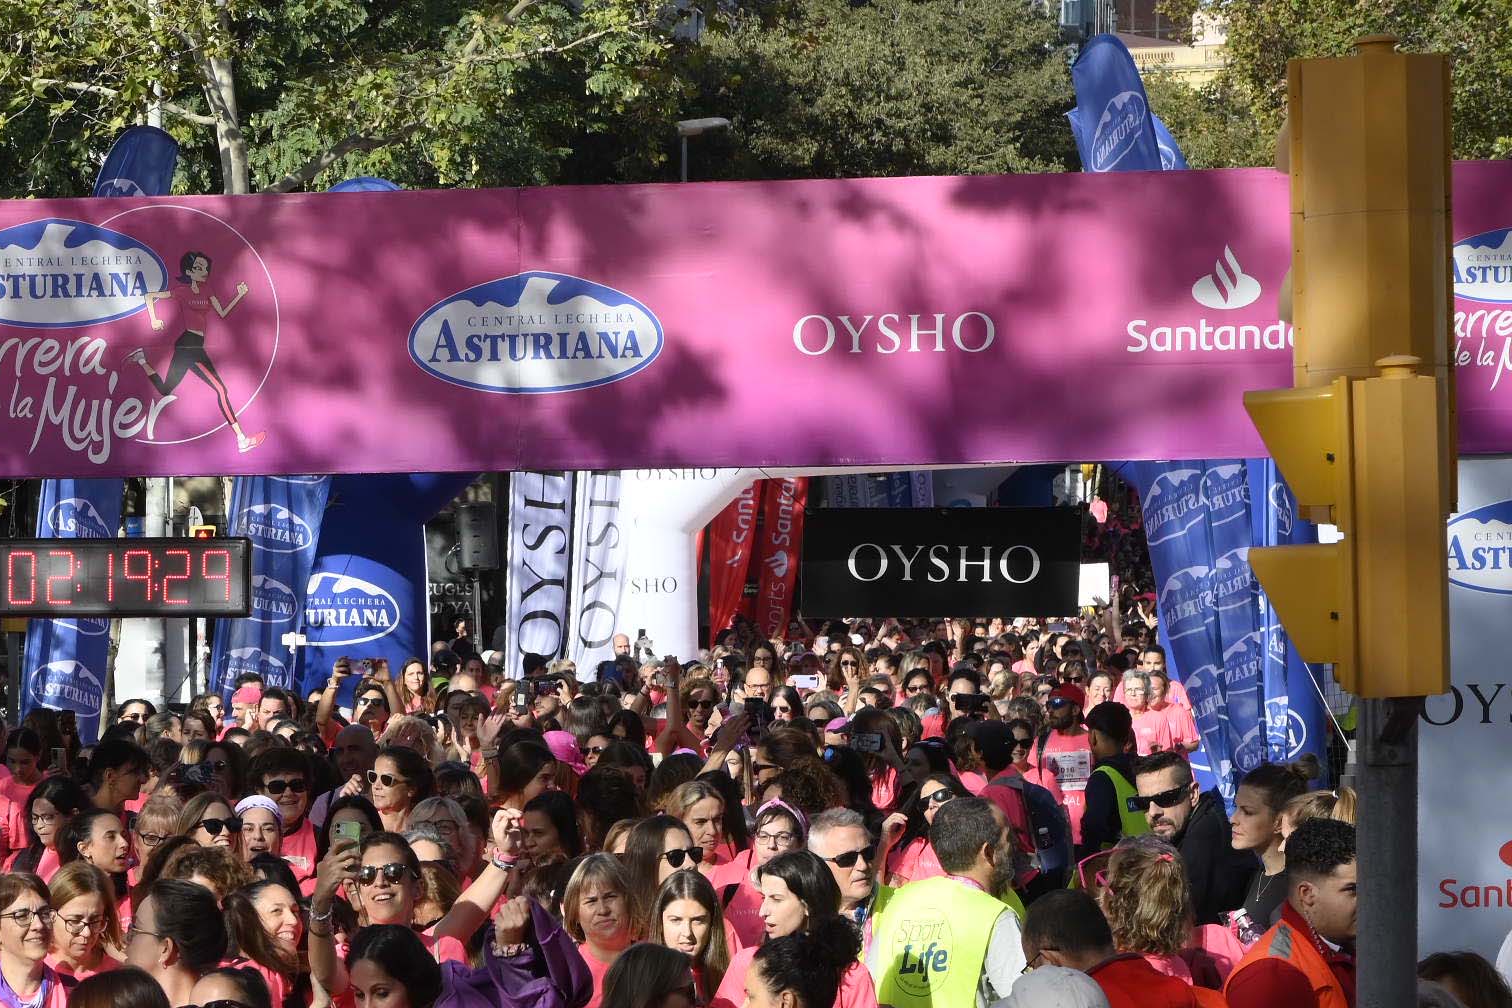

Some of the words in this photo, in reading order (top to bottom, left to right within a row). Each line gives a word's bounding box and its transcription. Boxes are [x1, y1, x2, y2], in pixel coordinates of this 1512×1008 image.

[71, 255, 143, 267] LECHERA
[467, 313, 544, 327] CENTRAL
[554, 312, 635, 325] LECHERA
[792, 311, 995, 357] OYSHO
[429, 319, 643, 363] ASTURIANA
[1476, 338, 1495, 366] la
[9, 381, 33, 418] la
[28, 371, 178, 464] Mujer
[7, 550, 231, 605] 02:19:29
[848, 543, 1040, 583] OYSHO
[337, 597, 386, 606] LECHERA
[628, 576, 678, 594] SHO
[35, 675, 101, 709] ASTURIANA
[1419, 683, 1512, 727] OY
[899, 942, 948, 983] Life
